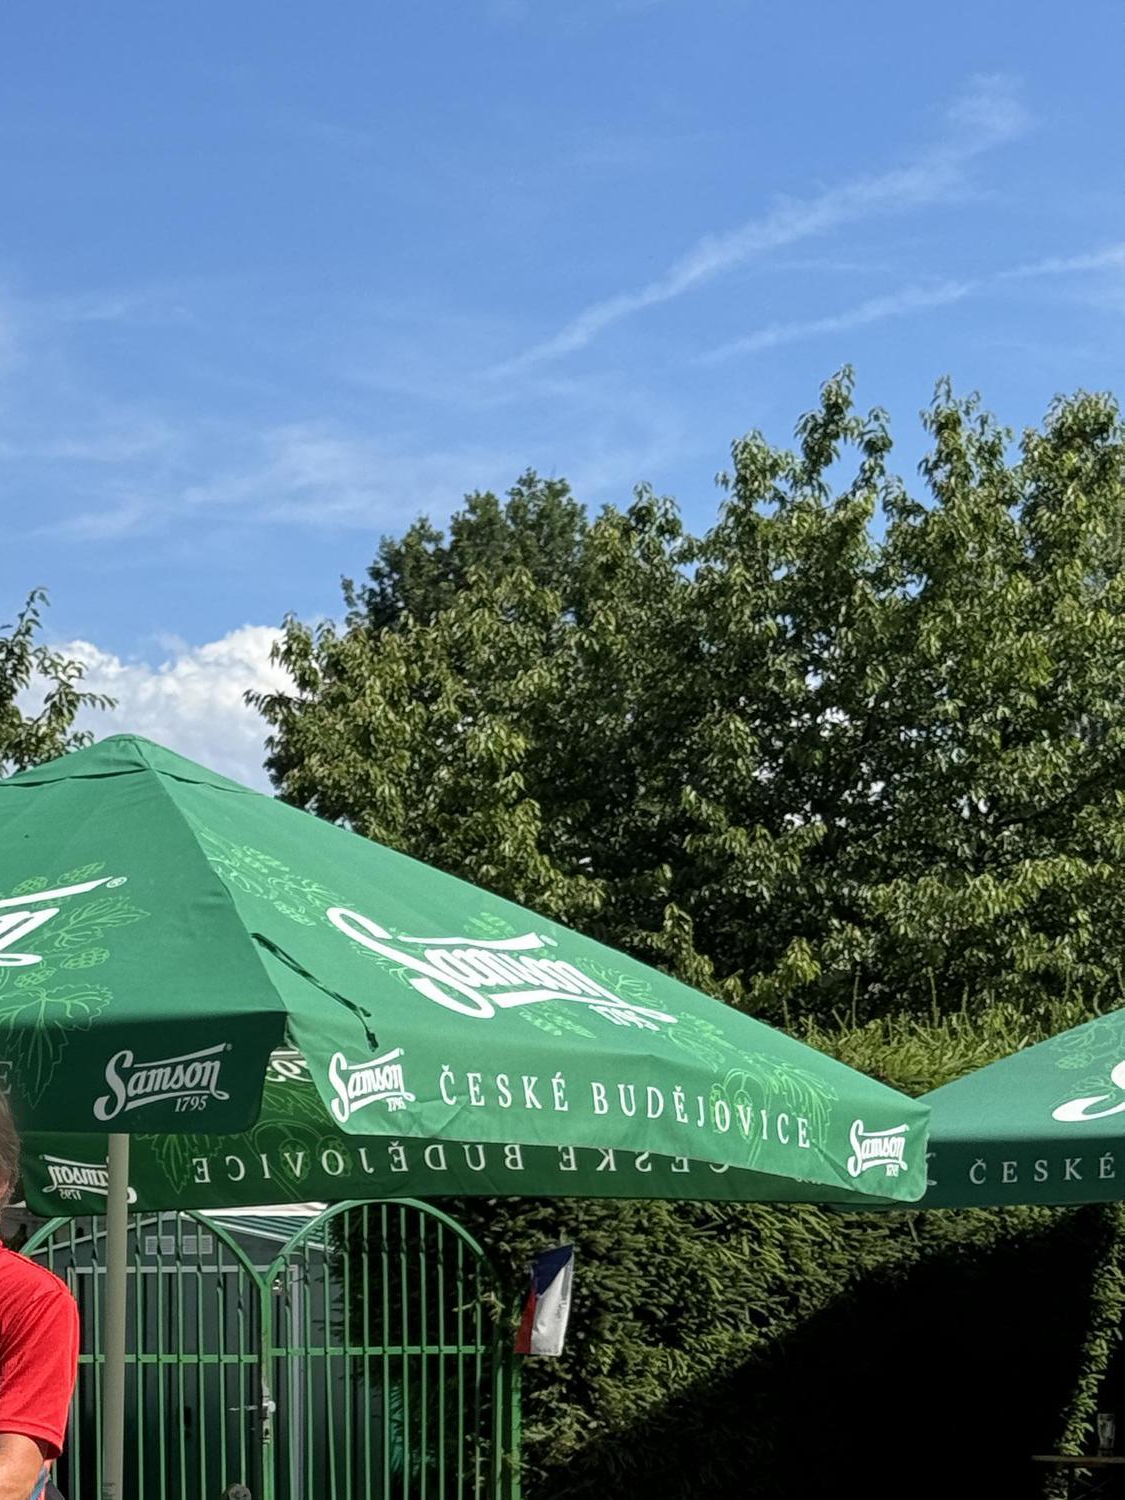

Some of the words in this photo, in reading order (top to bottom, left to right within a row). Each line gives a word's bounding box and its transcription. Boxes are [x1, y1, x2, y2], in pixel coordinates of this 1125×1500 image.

[93, 1042, 231, 1122] Samson
[175, 1095, 207, 1113] 1795
[328, 1047, 416, 1123] Samson
[439, 1063, 569, 1112] ČESKÉ
[591, 1082, 811, 1149] BUDĚJOVICE
[847, 1119, 909, 1178] Samson
[969, 1152, 1116, 1185] ČESKÉ
